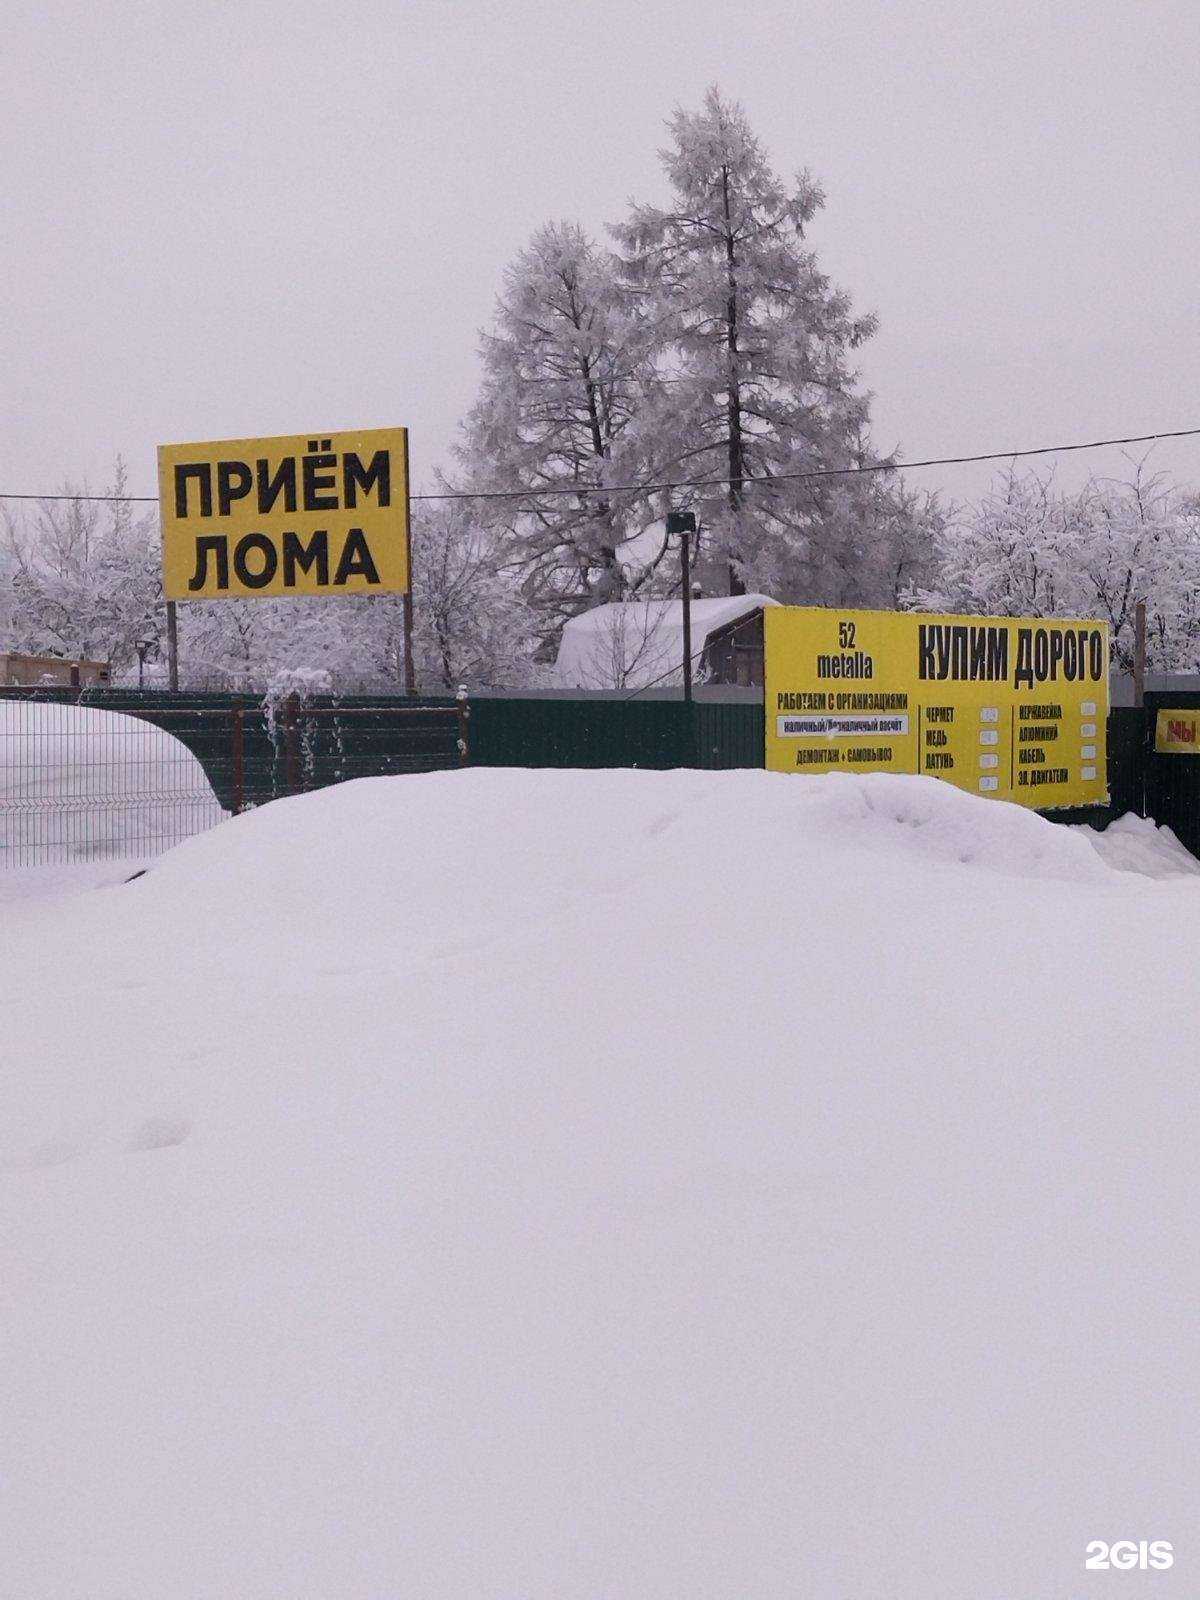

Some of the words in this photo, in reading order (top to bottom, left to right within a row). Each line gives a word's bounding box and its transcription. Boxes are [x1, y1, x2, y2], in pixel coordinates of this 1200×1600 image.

[174, 439, 391, 518] ПРИЁМ
[188, 528, 381, 592] ЛОМА
[838, 622, 856, 649] 52
[817, 651, 873, 679] metalla
[918, 624, 1008, 681] КУПИМ
[1014, 628, 1103, 690] ДОРОГО
[777, 692, 826, 710] РАБОТАЕМ
[828, 693, 835, 710] С
[836, 693, 908, 712] ОРГАНИЗАЦИЯМИ
[926, 706, 955, 723] ЧЕРМЕТ
[925, 729, 948, 747] МЕДЬ
[796, 748, 840, 766] ДЕМОНТАЖ
[847, 747, 893, 763] САМОВЫВОЗ
[925, 752, 954, 769] ЛАТУНЬ
[1018, 748, 1046, 764] КАБЕЛЬ
[1030, 768, 1069, 787] ДВИГАТЕЛИ
